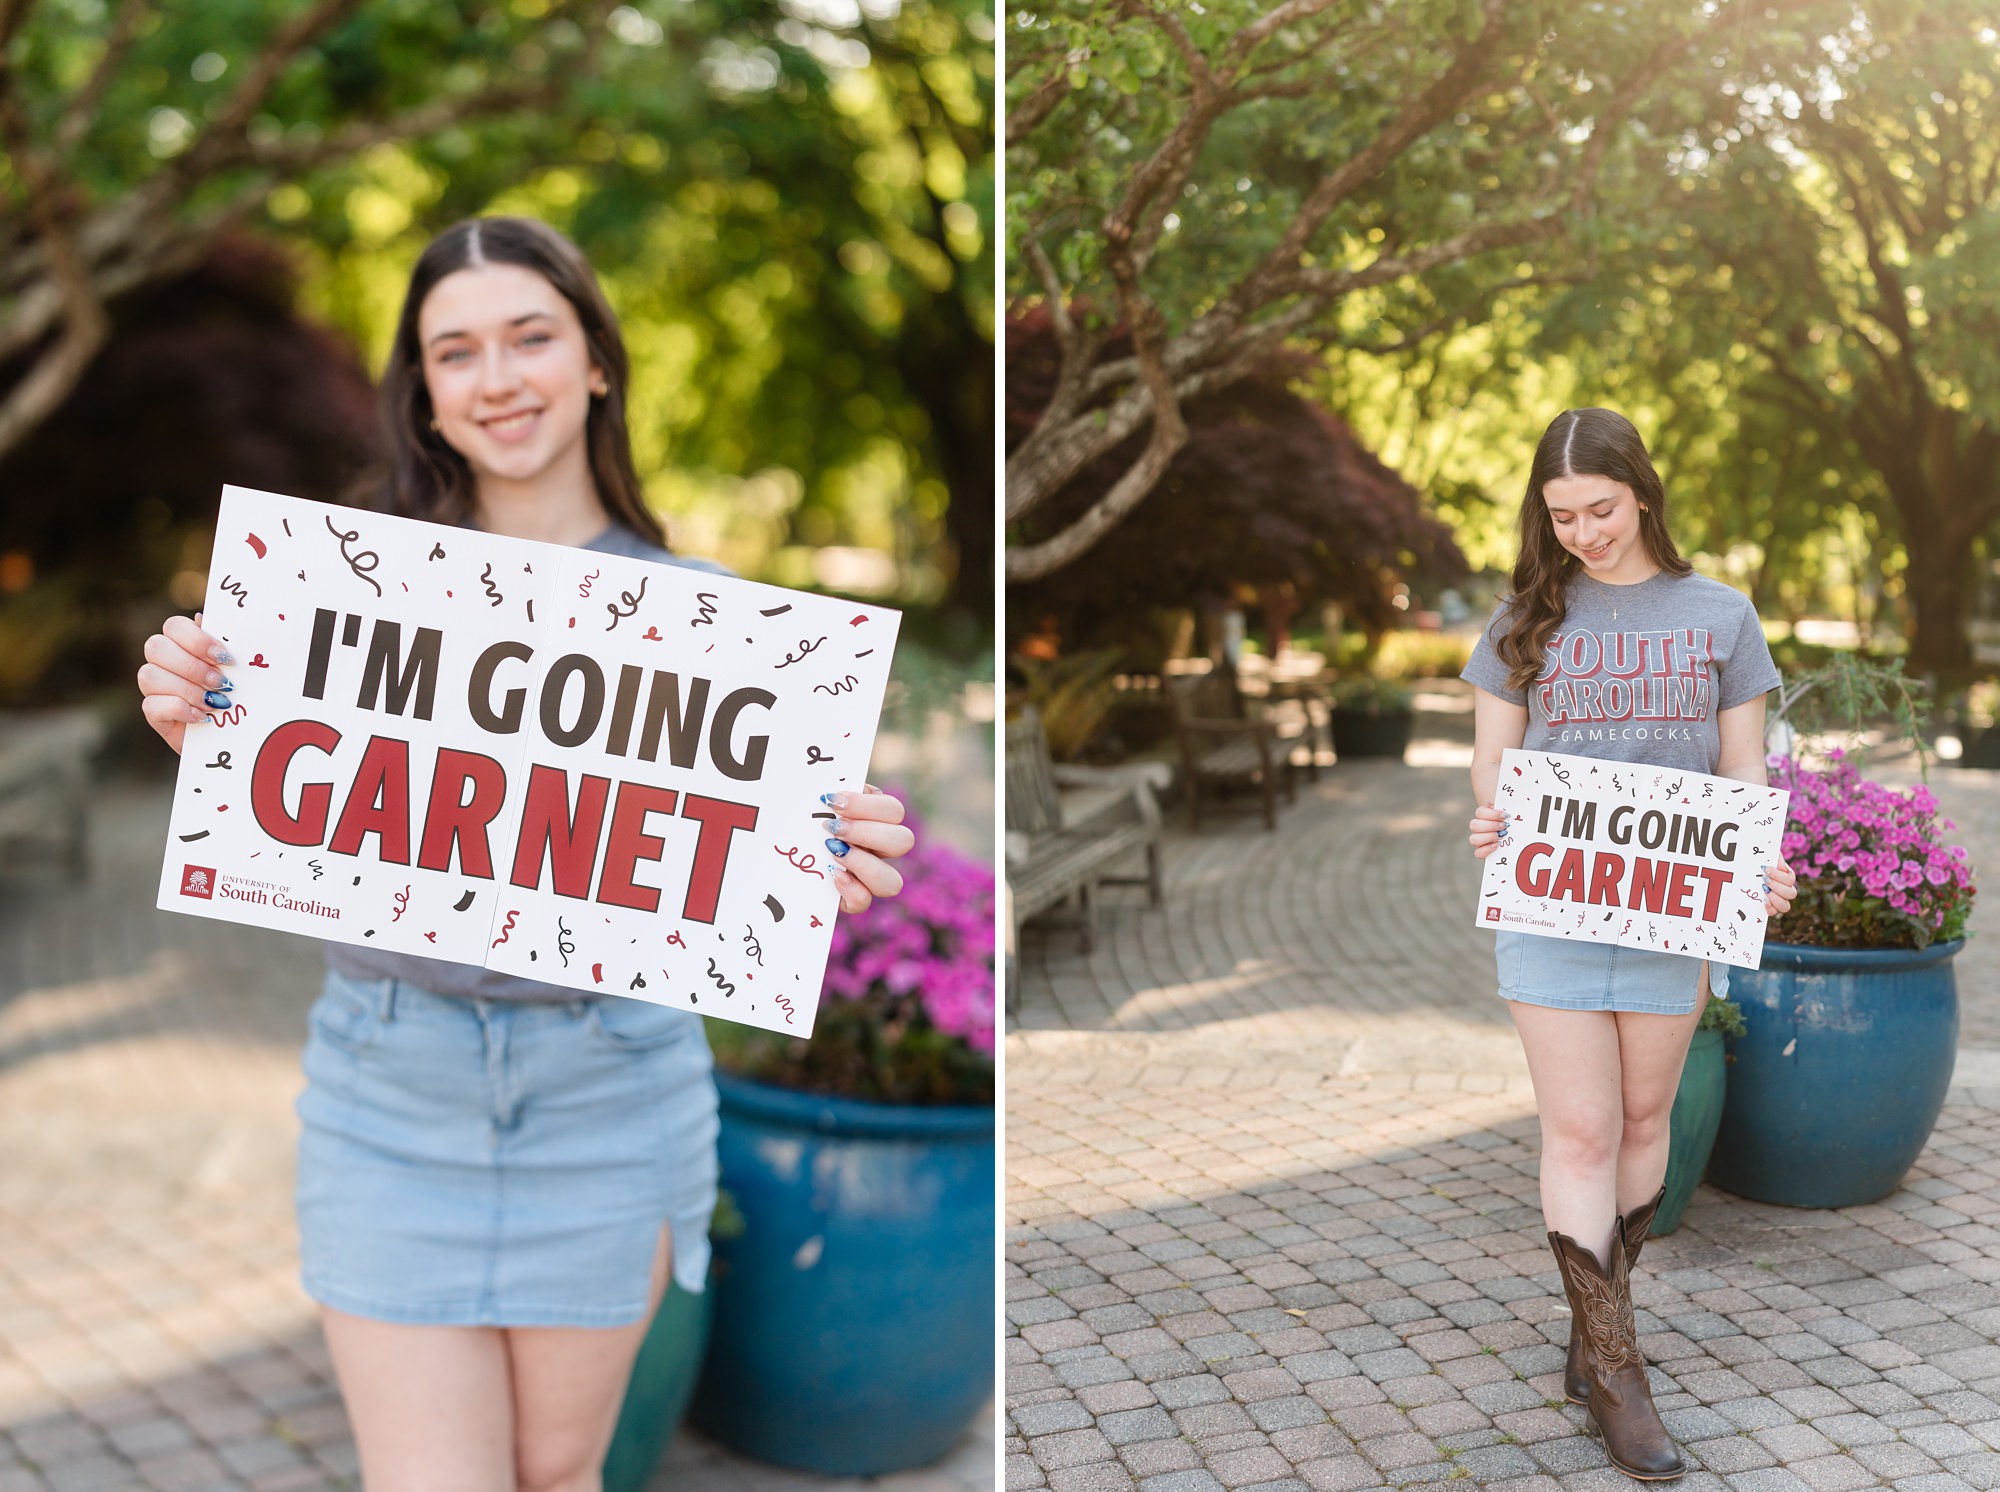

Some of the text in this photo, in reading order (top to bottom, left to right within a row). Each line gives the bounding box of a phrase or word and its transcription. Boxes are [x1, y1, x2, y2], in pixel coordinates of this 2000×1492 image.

[1535, 628, 1714, 684] SOUTH
[301, 607, 778, 782] I'M GOING
[1537, 676, 1711, 728] CAROLINA
[250, 718, 761, 926] GARNET
[1537, 794, 1740, 862] I'M GOING
[219, 883, 342, 920] South Carolina
[222, 874, 292, 894] UNIVERSITY OF
[1515, 841, 1735, 923] GARNET
[1502, 913, 1556, 928] South Carolina
